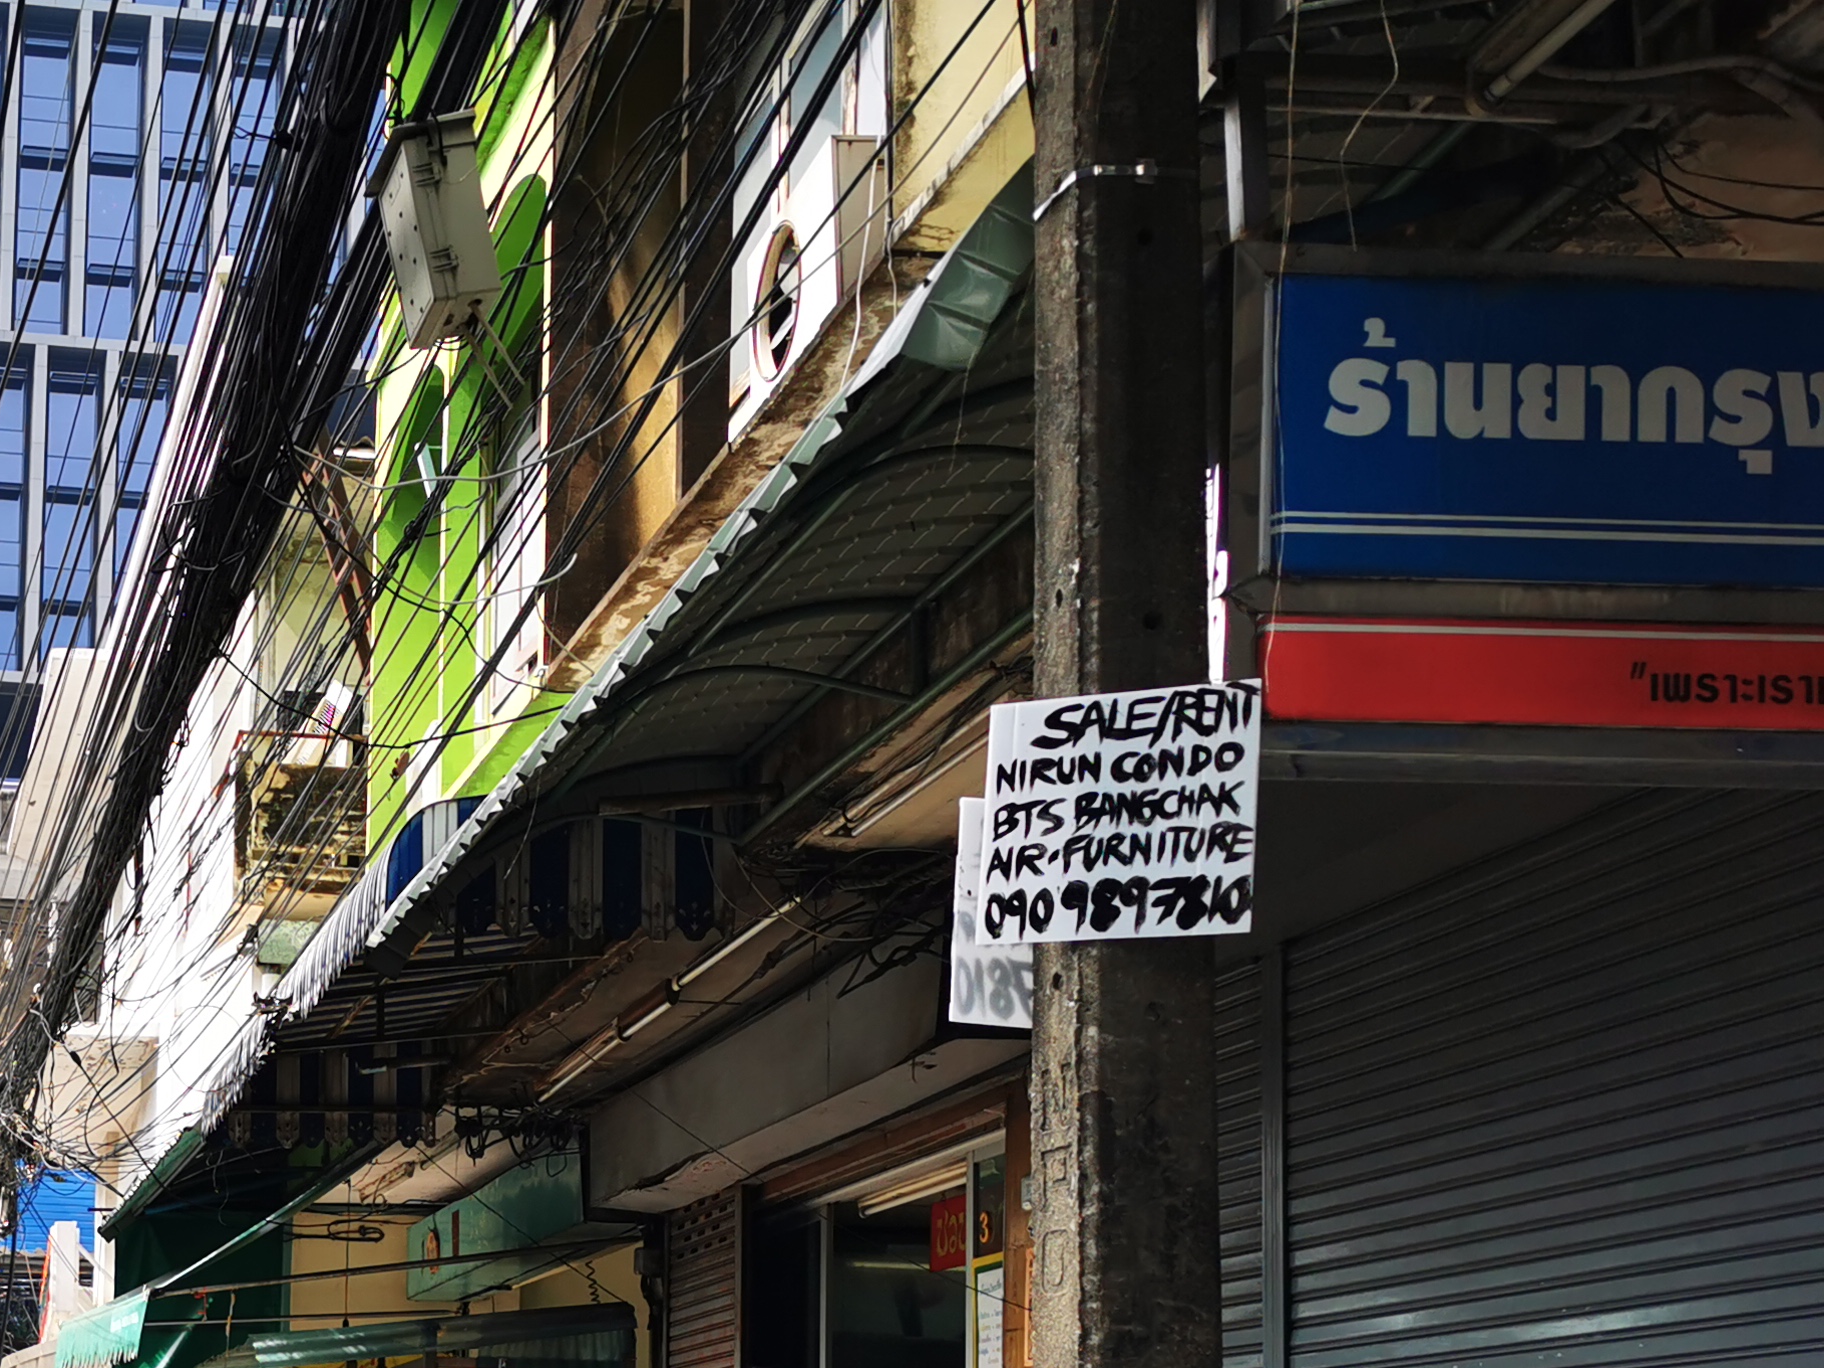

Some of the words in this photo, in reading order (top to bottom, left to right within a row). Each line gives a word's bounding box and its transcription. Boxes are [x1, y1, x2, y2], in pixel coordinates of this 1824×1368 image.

[1630, 661, 1824, 705] "เพราะเรา
[996, 751, 1102, 795] NIRUN
[1110, 742, 1246, 784] CONDO
[992, 798, 1068, 842] BTS
[1073, 781, 1247, 835] BANGCHAK
[984, 887, 1054, 941] 090
